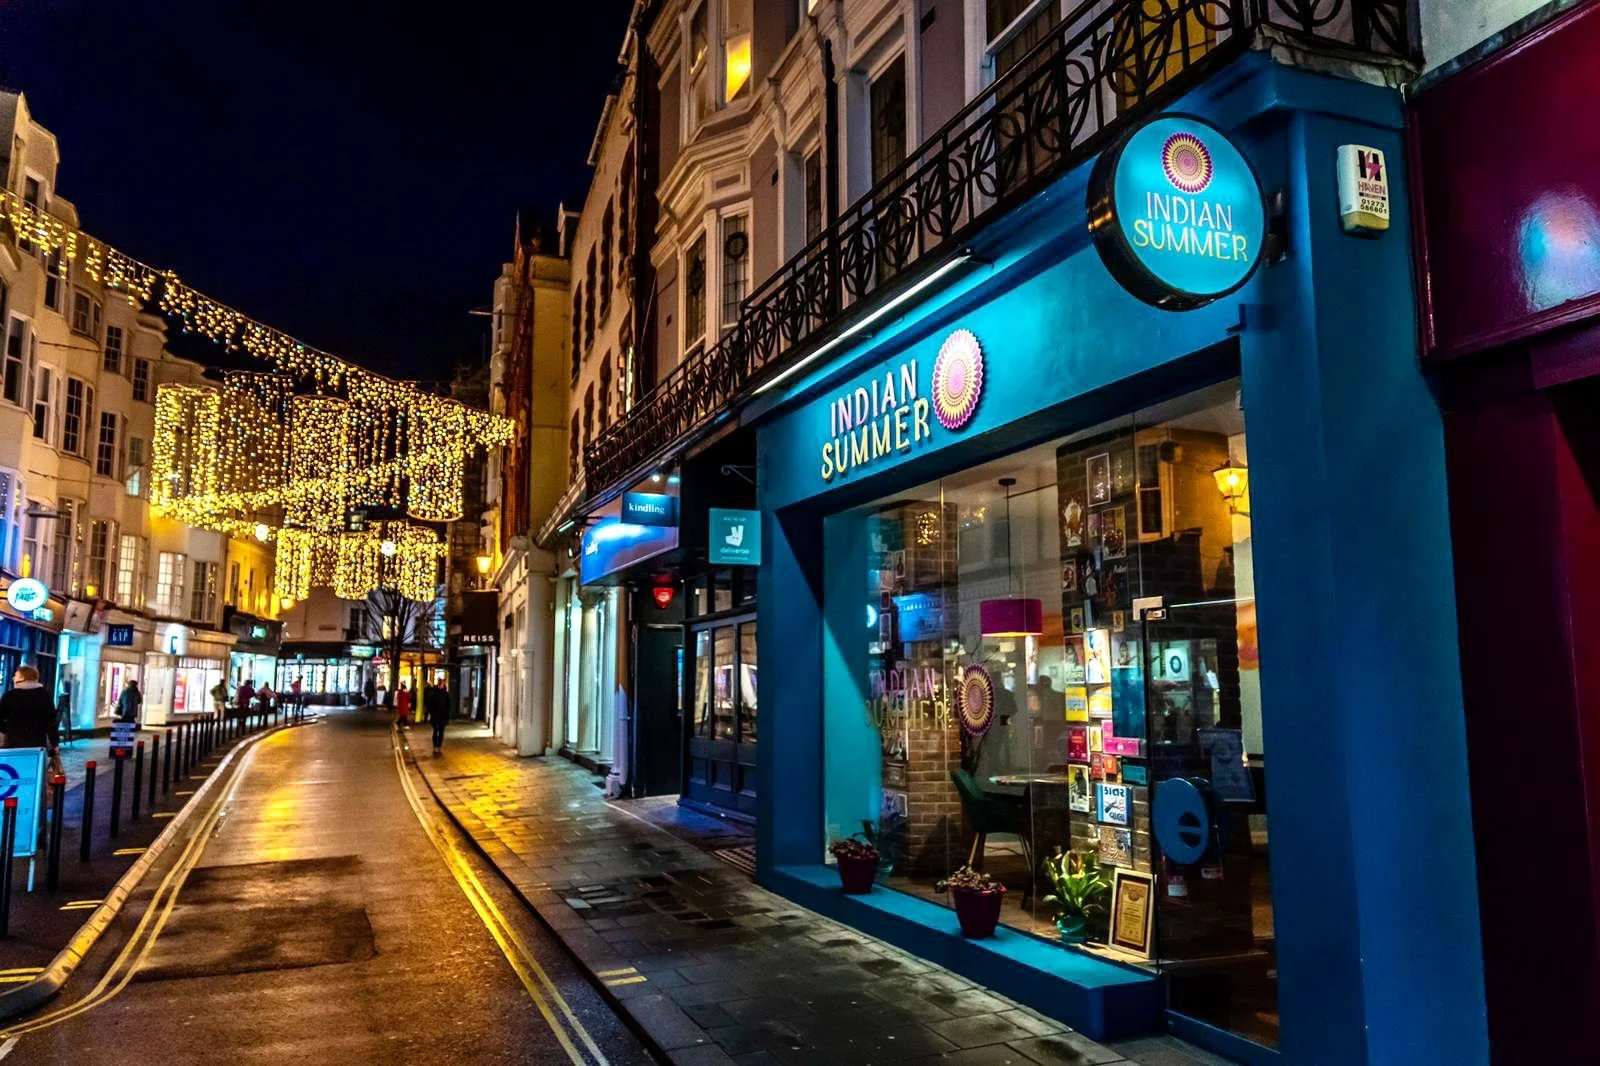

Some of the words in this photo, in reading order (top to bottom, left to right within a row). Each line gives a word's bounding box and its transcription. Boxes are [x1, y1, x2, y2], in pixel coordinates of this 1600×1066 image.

[1358, 181, 1386, 196] HAVEN
[1361, 199, 1385, 208] 01273
[1146, 191, 1233, 232] INDIAN
[1133, 219, 1249, 262] SUMMER
[830, 359, 918, 438] INDIAN
[821, 397, 930, 479] SUMMER
[628, 503, 666, 514] kindling
[463, 635, 495, 643] REISS
[869, 668, 937, 701] INDIAN
